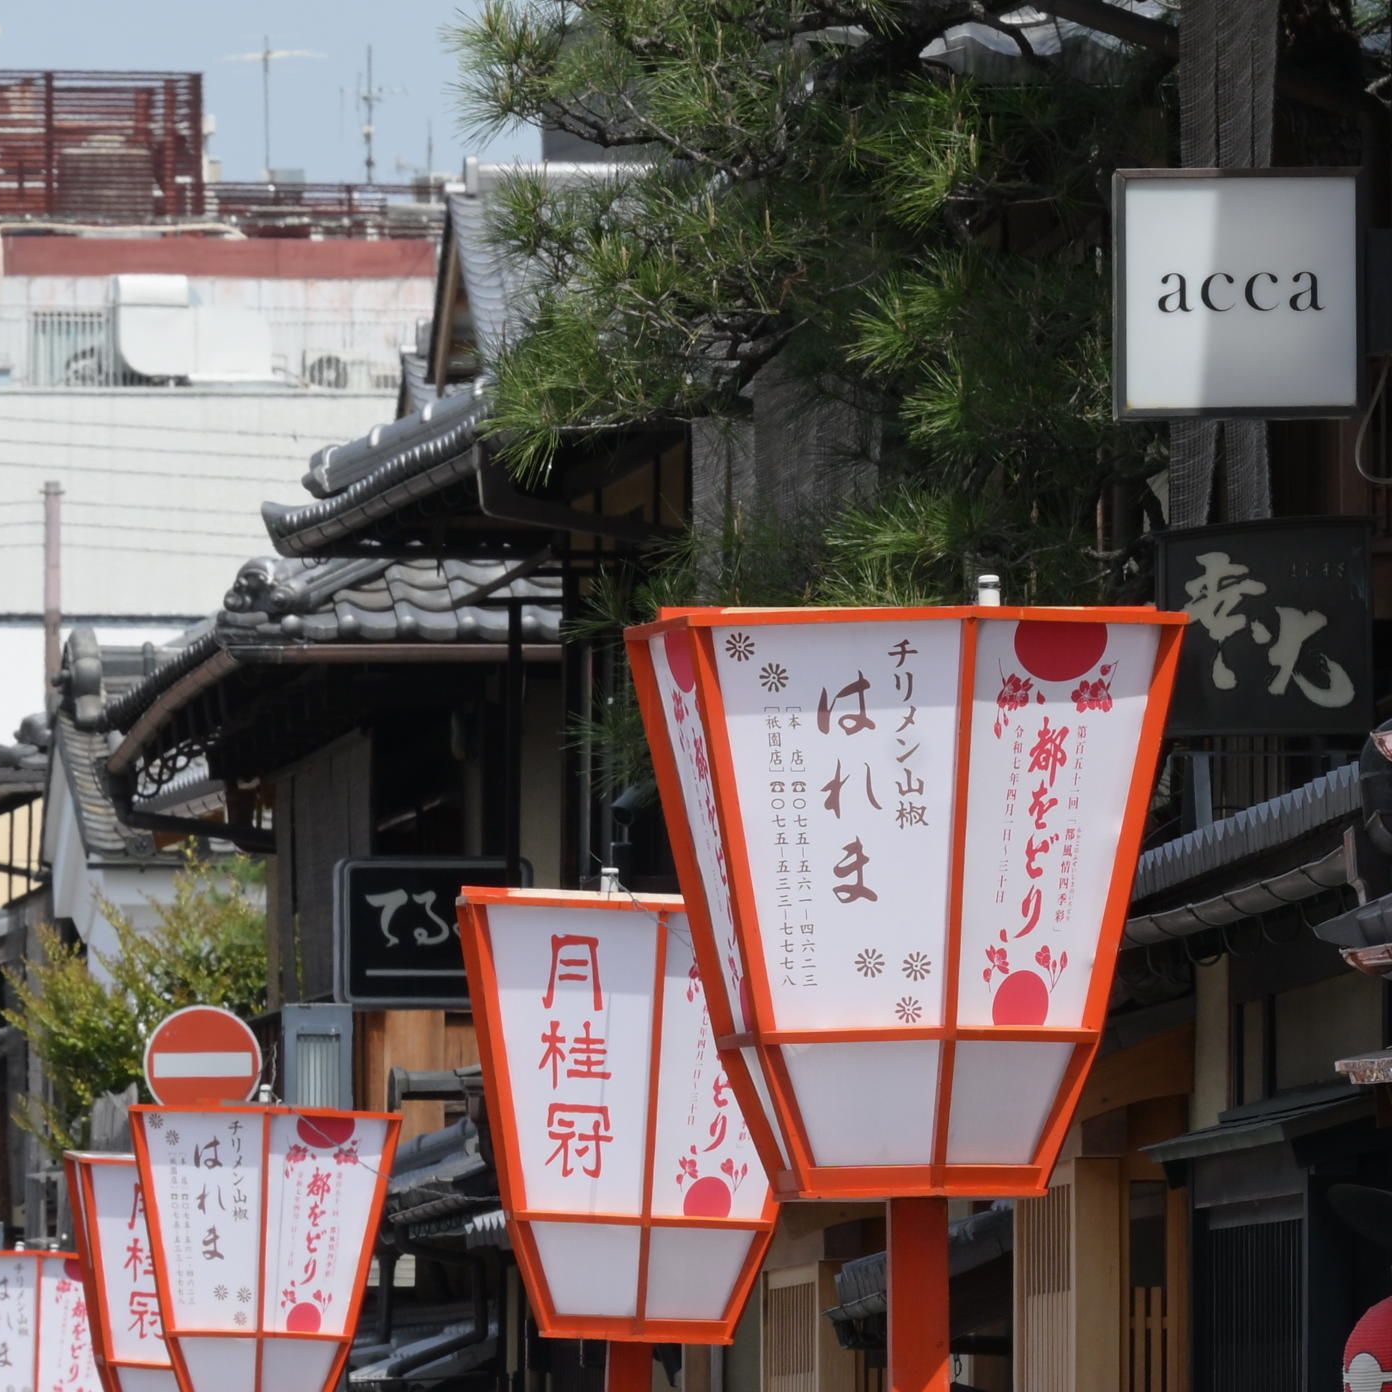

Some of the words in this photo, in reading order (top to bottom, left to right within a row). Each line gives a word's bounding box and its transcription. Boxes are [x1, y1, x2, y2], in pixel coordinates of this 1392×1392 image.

[1157, 268, 1326, 314] acca
[816, 669, 883, 904] はれま
[887, 638, 930, 830] チリメン山椒
[1013, 716, 1069, 939] 都をどり
[365, 889, 460, 949] てる
[538, 932, 614, 1180] 月桂冠
[193, 1135, 226, 1261] はれま
[228, 1120, 249, 1221] チリメン山椒
[300, 1166, 333, 1285] 都をどり
